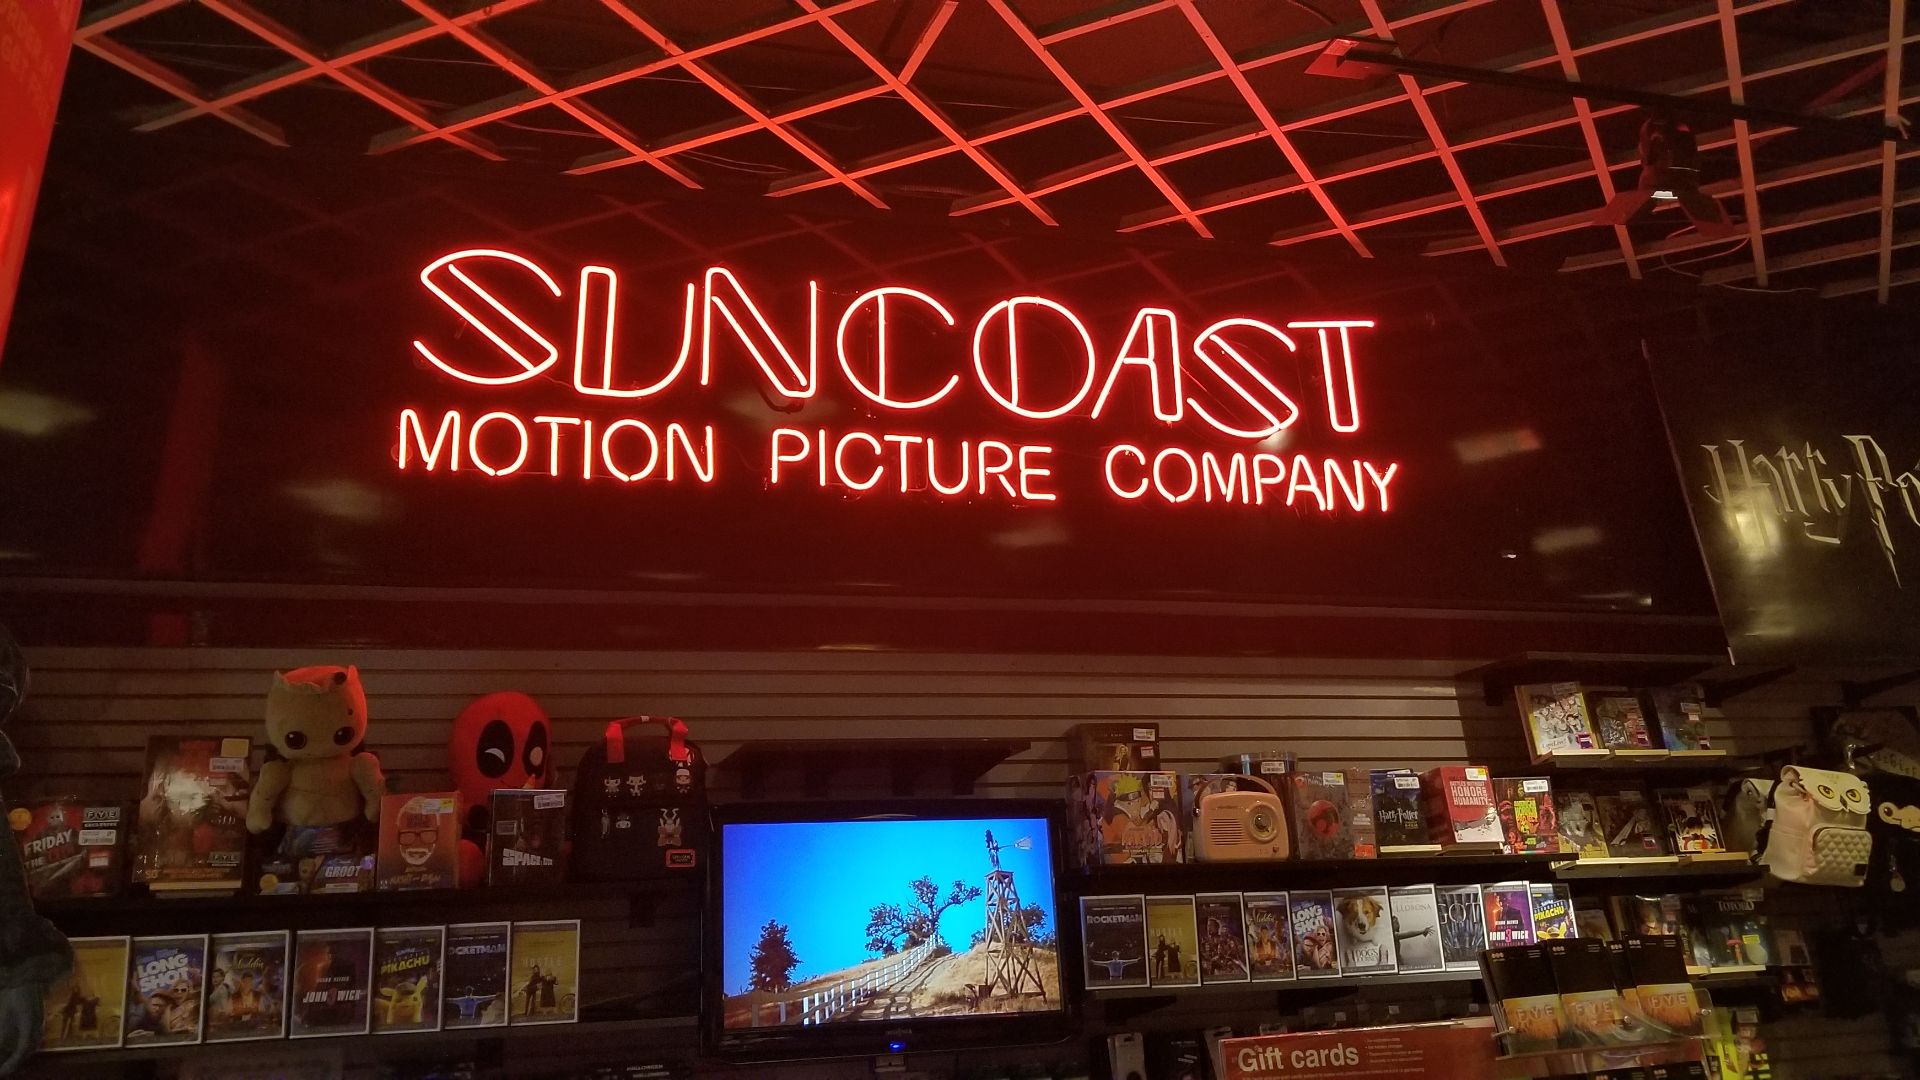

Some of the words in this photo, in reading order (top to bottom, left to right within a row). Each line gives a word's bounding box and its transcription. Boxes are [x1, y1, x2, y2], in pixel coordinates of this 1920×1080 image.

[412, 248, 1376, 438] SUNCOAST
[398, 408, 715, 483] MOTION
[770, 427, 1057, 501] PICTURE
[1104, 443, 1399, 513] COMPANY
[1700, 438, 1852, 555] Harry
[1451, 786, 1483, 797] HONOR
[1453, 796, 1489, 806] HUMANITY
[1378, 808, 1398, 824] Harry
[1396, 807, 1419, 825] Potter
[23, 828, 72, 859] FRIDAY
[324, 864, 362, 878] GROOT
[1086, 913, 1142, 924] ROCKETMAN
[1292, 904, 1323, 924] LONG
[1437, 902, 1481, 925] GOT
[1534, 905, 1566, 921] PIKACHU
[1294, 917, 1325, 933] SHOT
[1511, 930, 1529, 940] WICK
[448, 943, 507, 956] OCKETMAN
[136, 953, 189, 979] LONG
[380, 955, 431, 976] PIKACHU
[139, 967, 190, 992] SHOT
[302, 991, 328, 1004] JOHN
[336, 989, 361, 1001] WICK
[1237, 1045, 1284, 1072] Gift
[1290, 1043, 1360, 1069] cards
